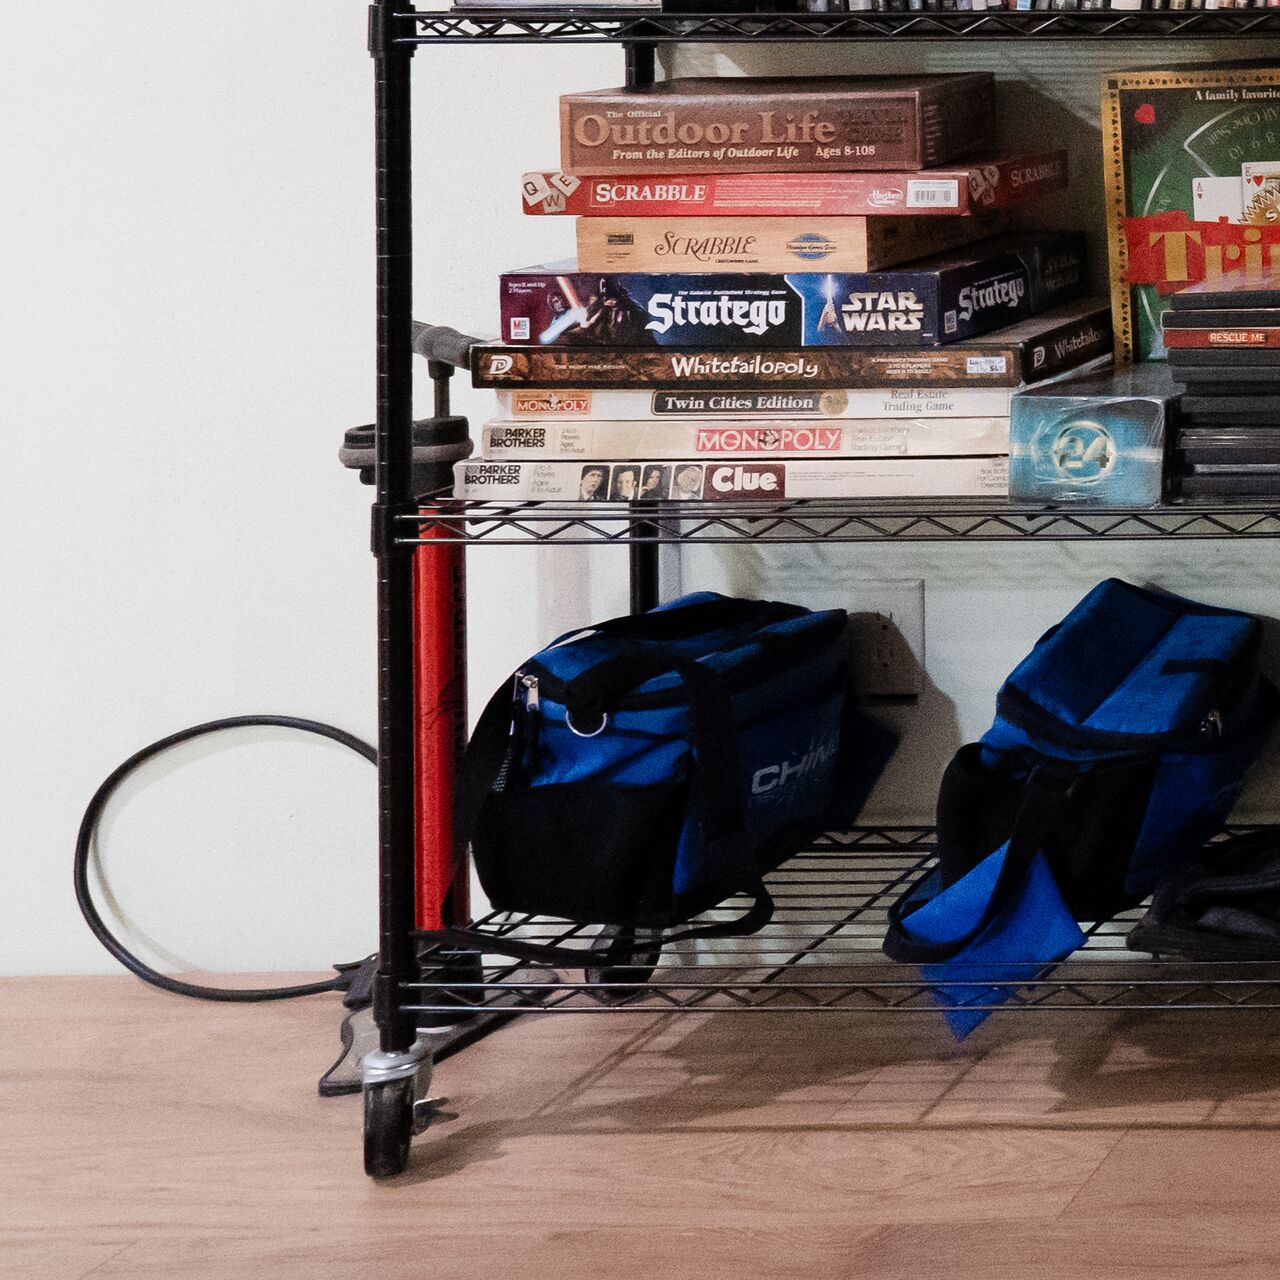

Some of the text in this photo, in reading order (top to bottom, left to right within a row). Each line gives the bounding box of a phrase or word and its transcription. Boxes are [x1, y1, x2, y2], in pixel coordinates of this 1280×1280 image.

[1194, 90, 1240, 101] A family
[573, 110, 837, 147] Outdoor Life
[612, 146, 841, 159] From Editors Outdoor Ages
[595, 183, 706, 203] SCRABBLE
[654, 231, 757, 262] SCRABBLE
[842, 292, 923, 311] STAR
[958, 278, 1025, 321] Stratego
[644, 292, 788, 335] Stratego
[841, 311, 924, 332] WARS
[1209, 332, 1267, 344] RESCUE ME
[670, 355, 819, 378] Whitetailopoly
[665, 396, 813, 410] Twin Cities Edition
[490, 437, 546, 448] BROTHERS
[505, 428, 546, 439] PARKER
[699, 429, 842, 452] MONOPOLY
[1058, 434, 1113, 468] 24
[465, 475, 521, 486] BROTHERS
[711, 467, 779, 493] Clue
